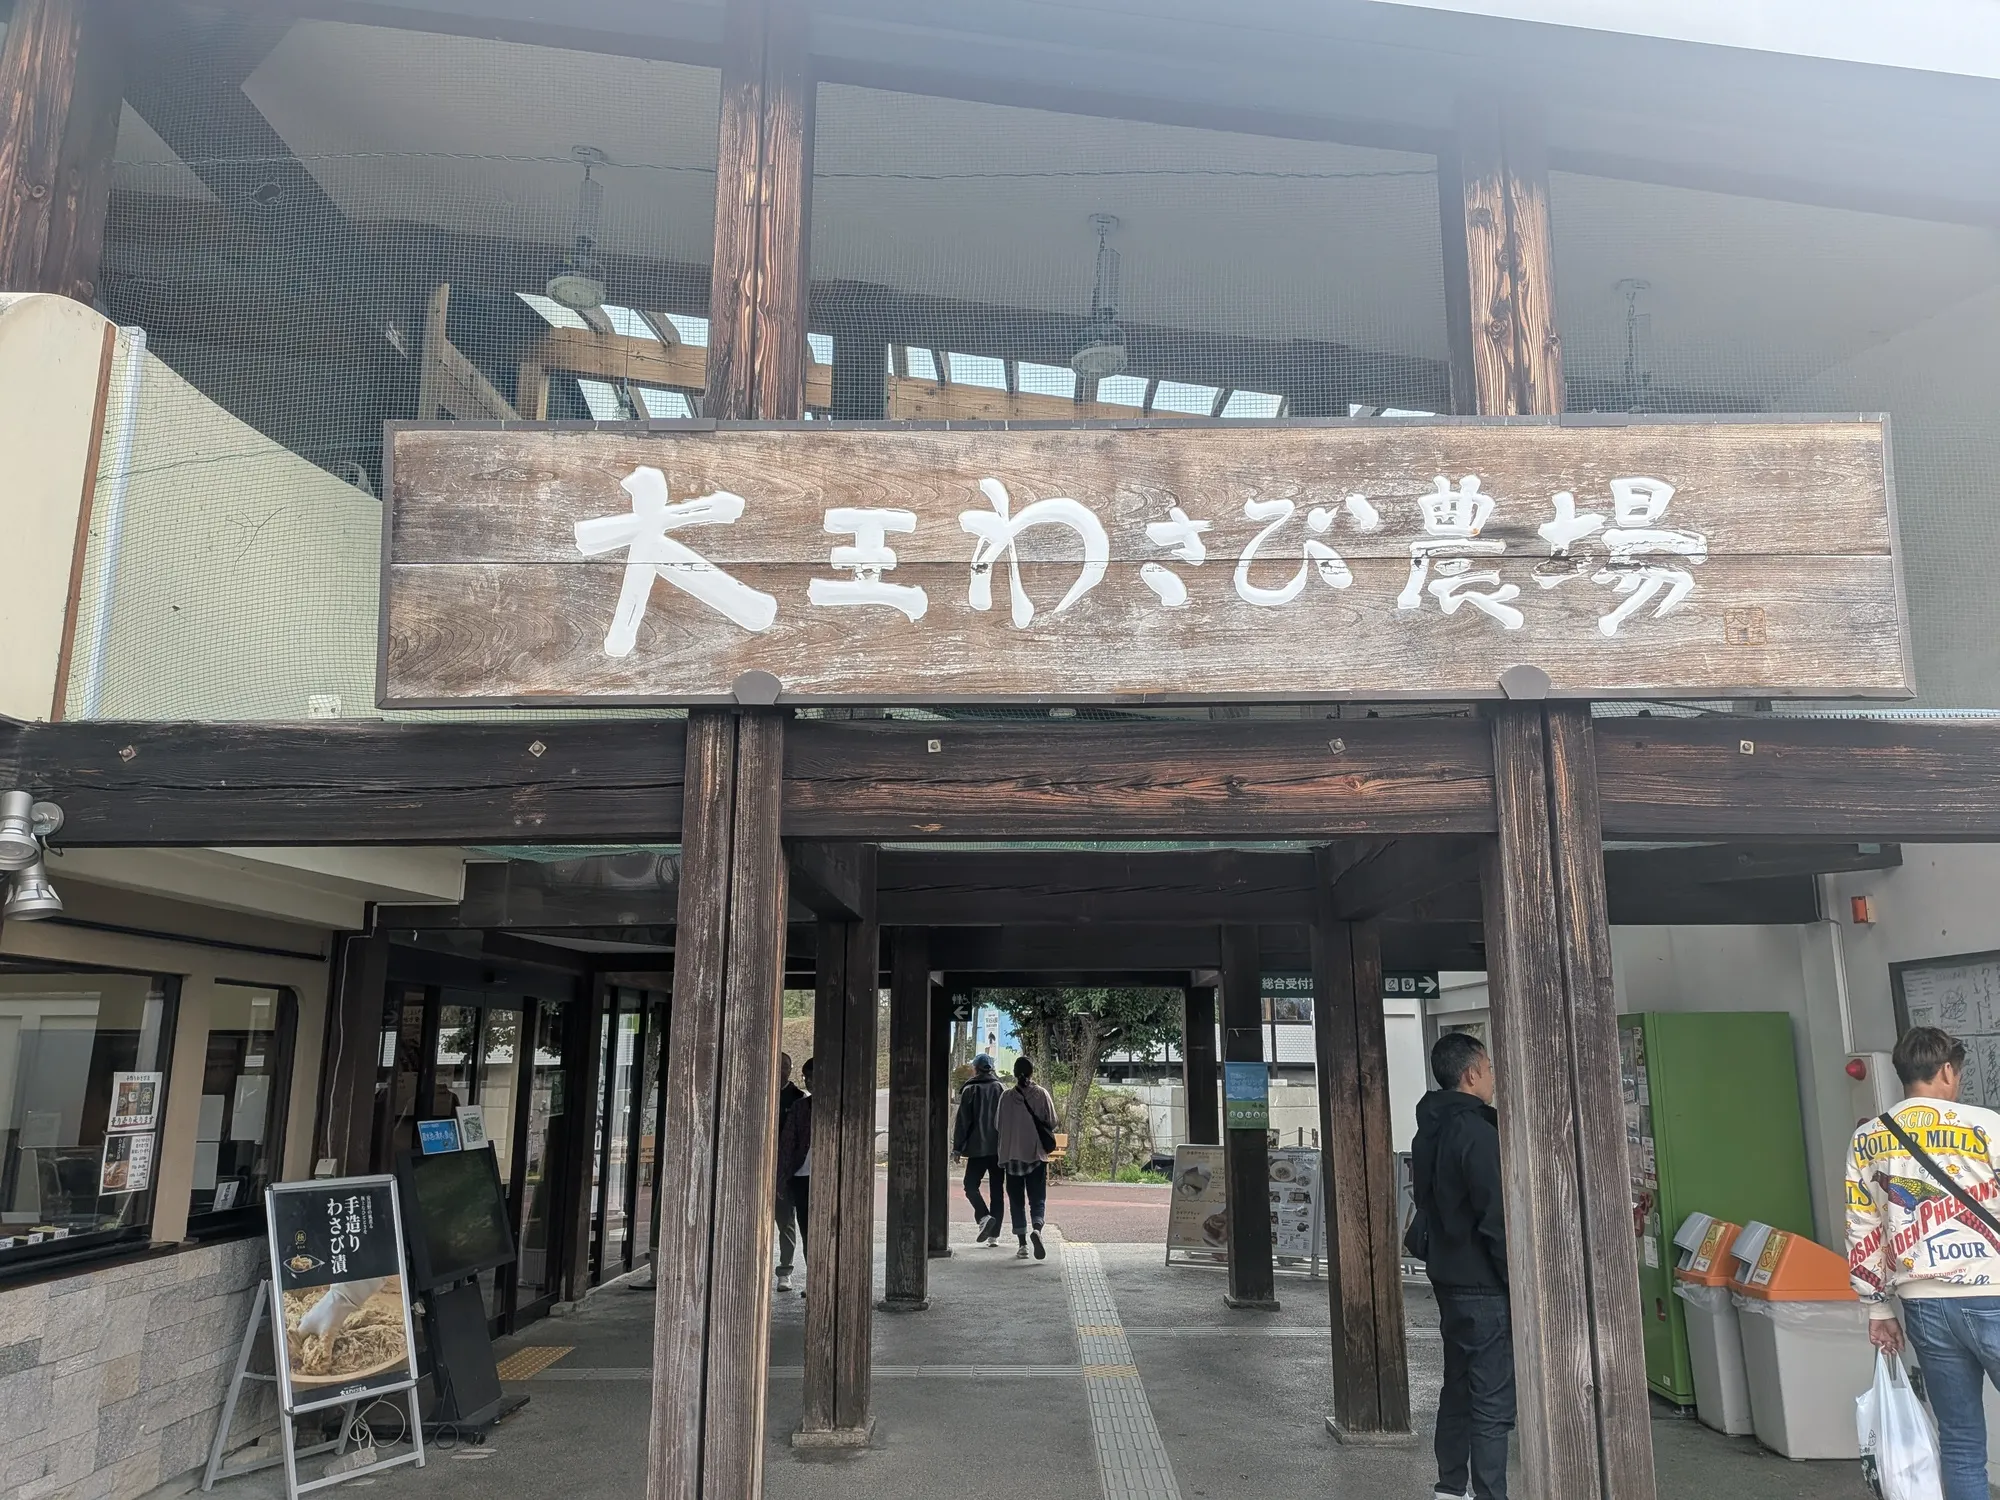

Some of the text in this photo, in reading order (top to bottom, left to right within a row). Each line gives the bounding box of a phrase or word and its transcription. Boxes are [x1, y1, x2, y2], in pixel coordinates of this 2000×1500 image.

[573, 465, 1708, 658] 大王わさび農場
[1898, 1110, 1934, 1129] SCIO
[1926, 1125, 1987, 1155] MILLS
[344, 1195, 361, 1253] 手造り
[1920, 1178, 1998, 1236] PHEAANT
[327, 1198, 348, 1275] わさび漬
[1923, 1228, 1992, 1268] FLOUR
